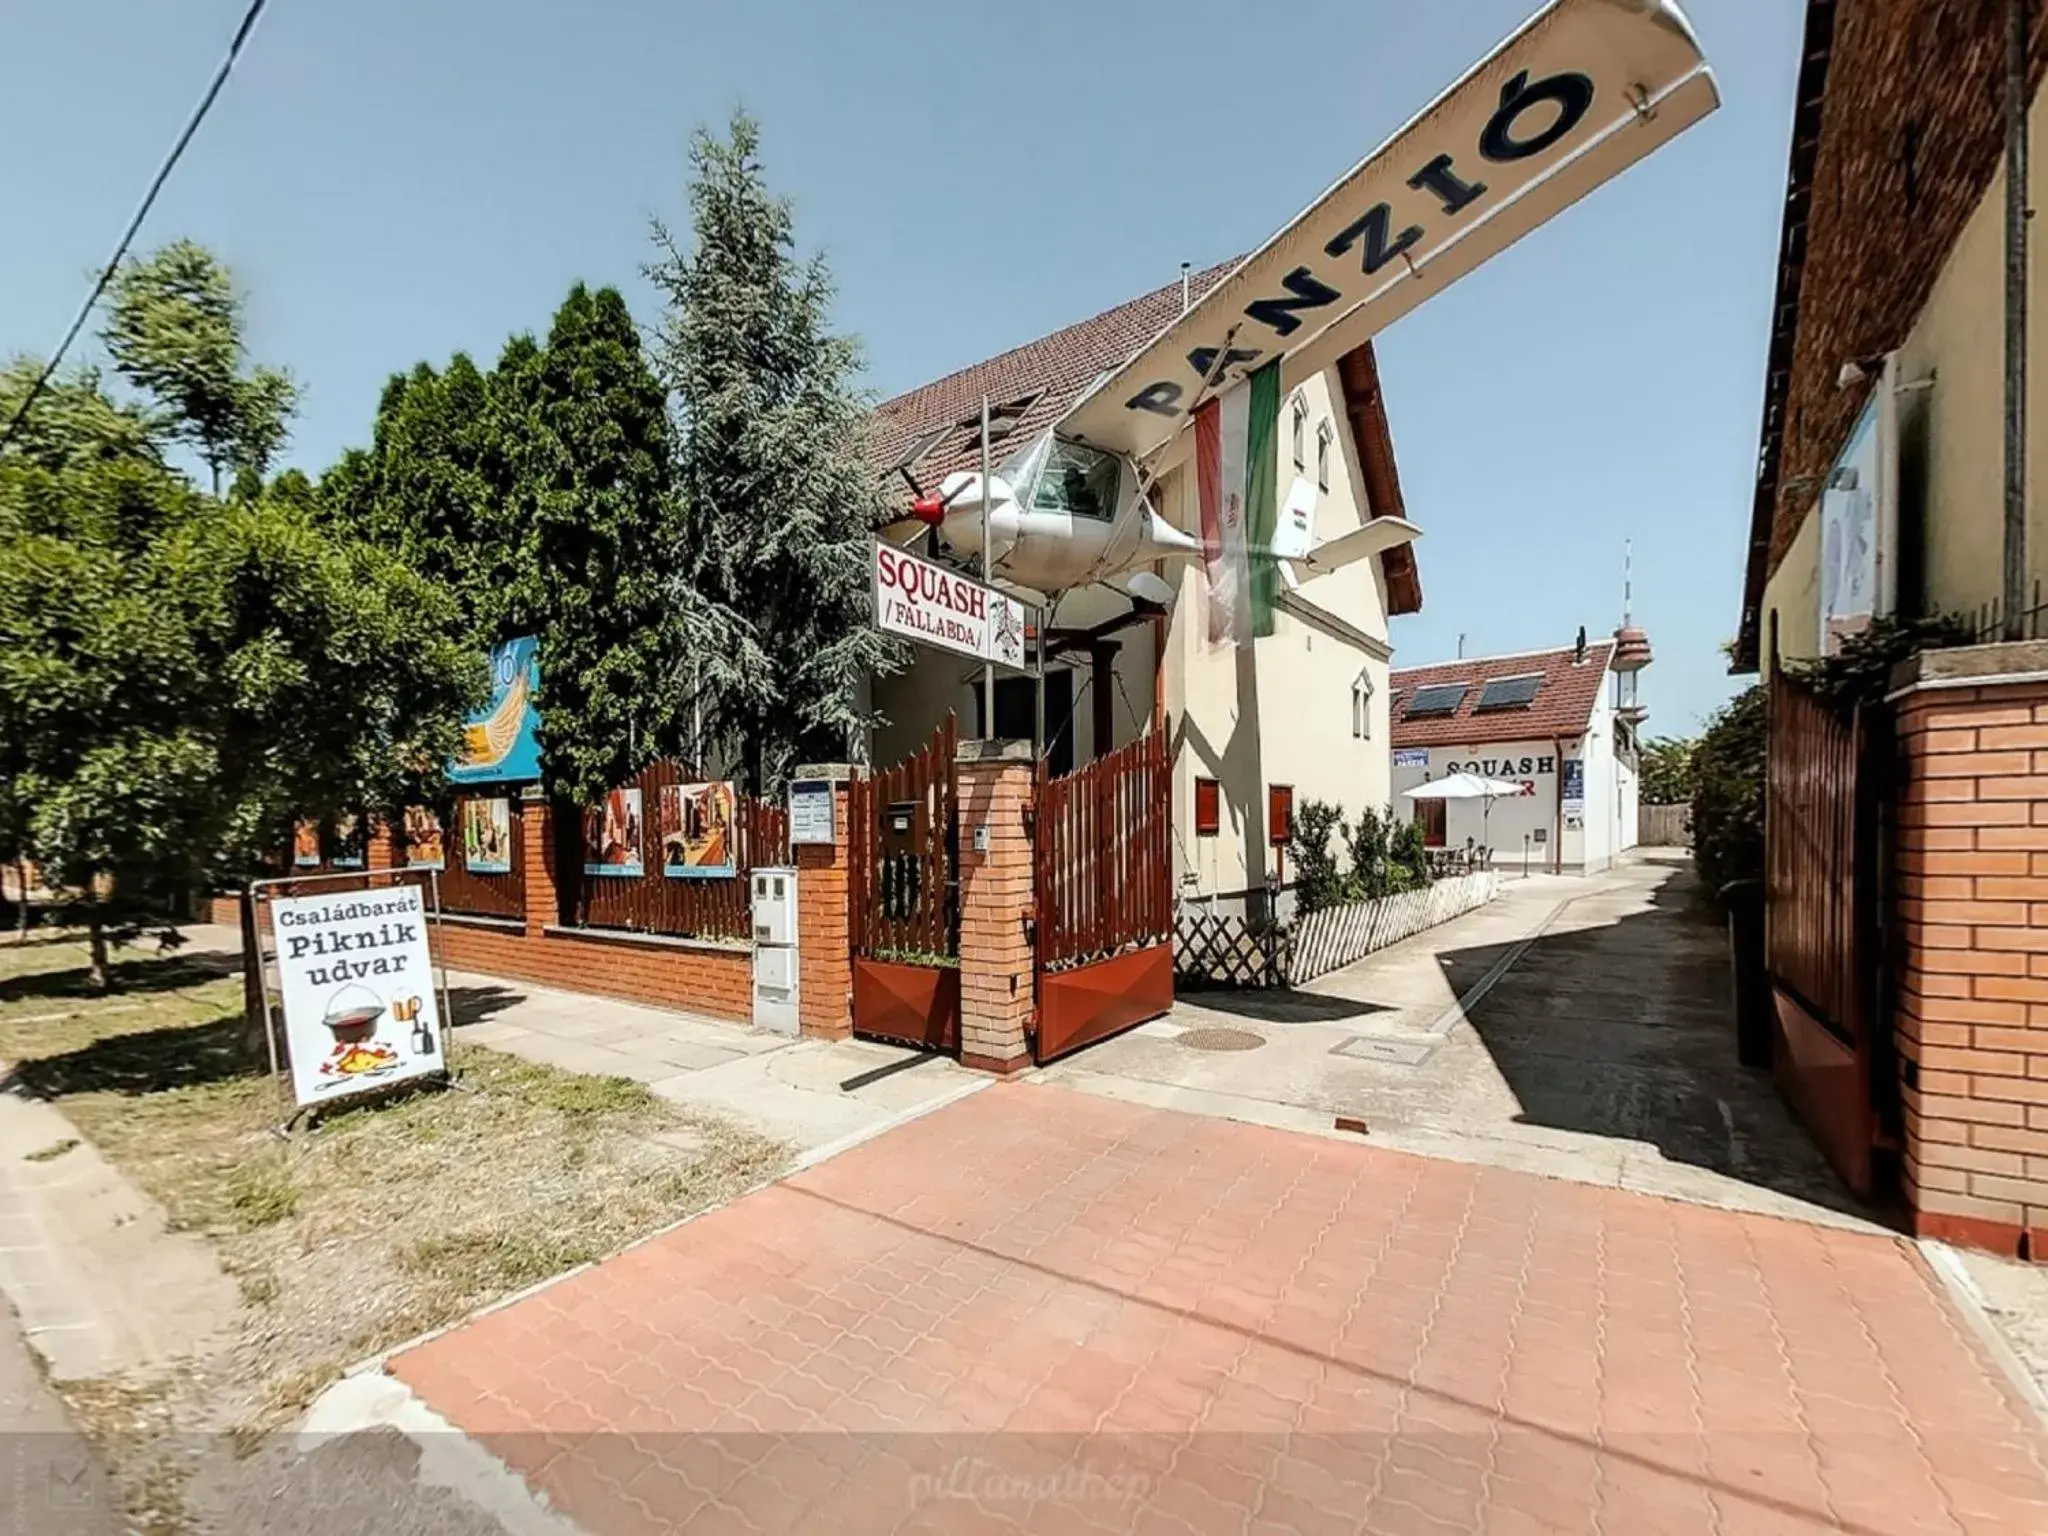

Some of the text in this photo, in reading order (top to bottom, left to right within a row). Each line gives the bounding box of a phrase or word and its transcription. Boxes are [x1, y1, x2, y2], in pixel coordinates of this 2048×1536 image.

[1124, 69, 1594, 418] PANZIÓ
[878, 550, 986, 621] SQUASH
[1446, 756, 1555, 777] SQUASH
[280, 897, 417, 926] Családbarát
[287, 923, 417, 959] Piknik
[306, 954, 408, 985] udvar
